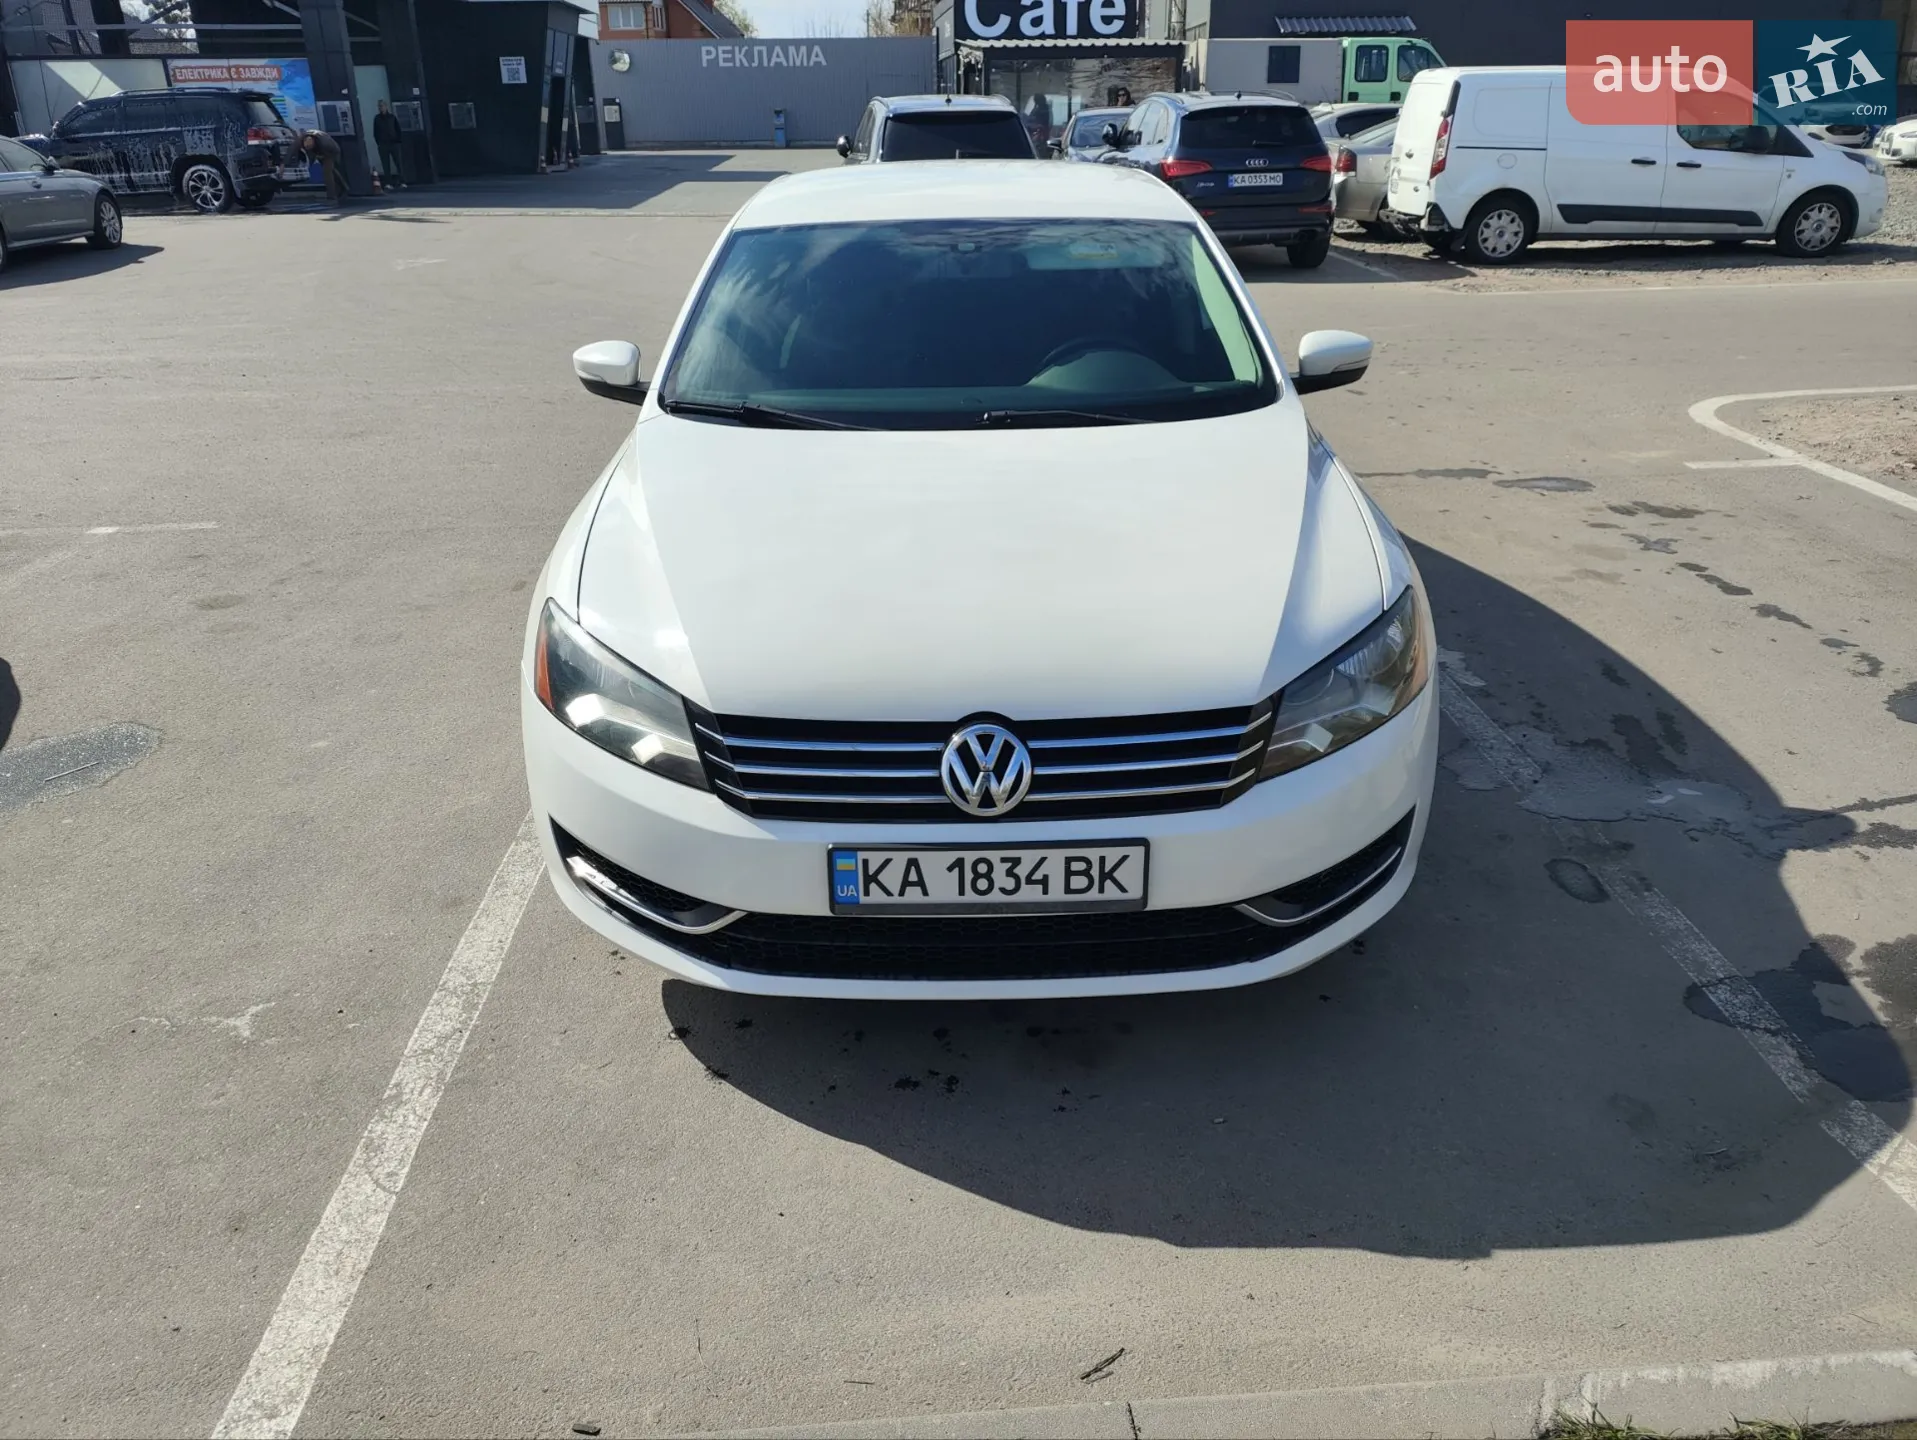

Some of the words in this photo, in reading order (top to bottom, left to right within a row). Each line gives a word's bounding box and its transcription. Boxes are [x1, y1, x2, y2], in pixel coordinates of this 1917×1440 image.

[964, 0, 1126, 38] Cafe
[701, 45, 828, 67] РЕКЛАМА
[175, 67, 230, 80] ЕЛЕКТРИКА
[239, 67, 279, 80] ЗАВЖДИ
[861, 857, 930, 898] KA
[946, 857, 1050, 896] 1834
[1063, 855, 1131, 896] BK
[837, 884, 858, 897] UA
